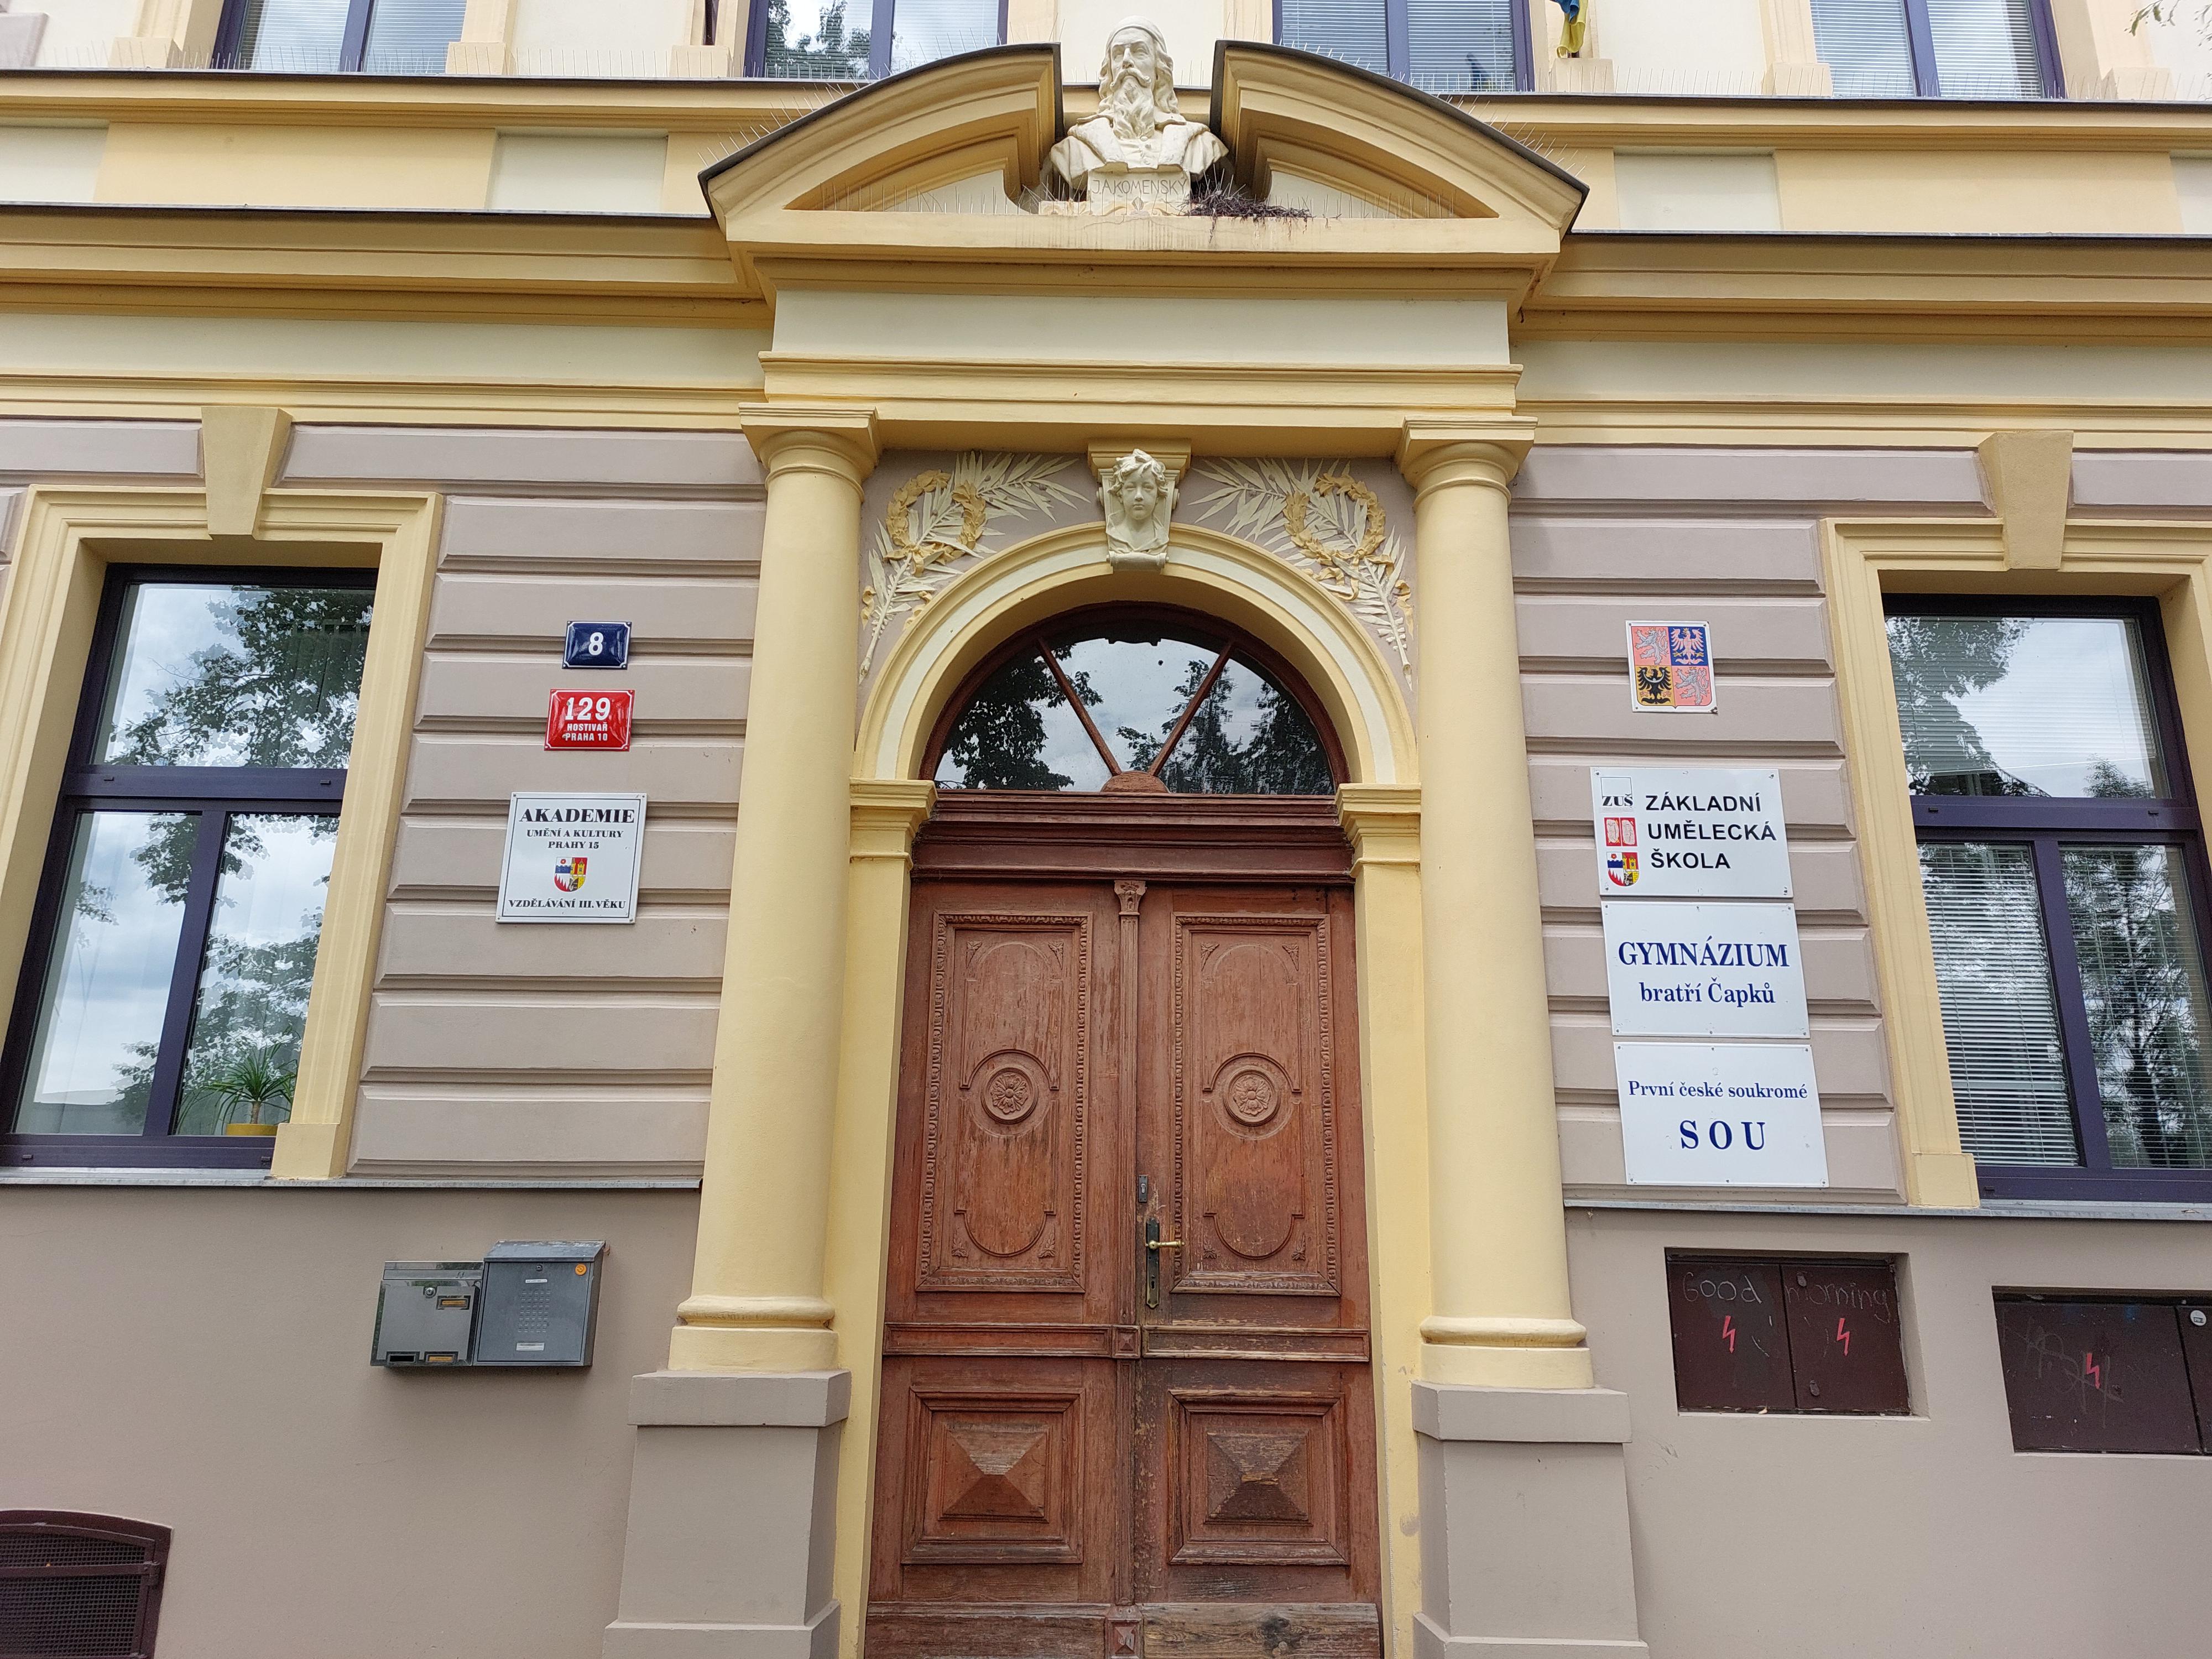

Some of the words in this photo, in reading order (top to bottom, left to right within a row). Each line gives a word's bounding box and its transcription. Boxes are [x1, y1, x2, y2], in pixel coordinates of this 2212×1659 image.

[588, 632, 604, 655] 8
[565, 697, 611, 720] 129
[567, 722, 608, 732] HOSTIVAŘ
[565, 733, 594, 741] PRAHA
[597, 733, 608, 741] 10
[1603, 794, 1634, 807] ZUŠ
[1646, 791, 1761, 812] ZÁKLADNÍ
[519, 808, 635, 823] AKADEMIE
[526, 828, 562, 837] UMĚNÍ
[1647, 820, 1777, 841] UMĚLECKÁ
[1651, 848, 1731, 869] ŠKOLA
[509, 898, 576, 908] VZDĚLÁVÁNÍ
[578, 900, 594, 909] III.
[596, 899, 626, 909] VĚKU
[1618, 935, 1790, 967] GYMNÁZIUM
[1639, 982, 1702, 1002] bratří
[1708, 977, 1776, 1007] Čapků
[1628, 1081, 1674, 1097] První
[1679, 1081, 1724, 1097] české
[1728, 1083, 1808, 1098] soukromé
